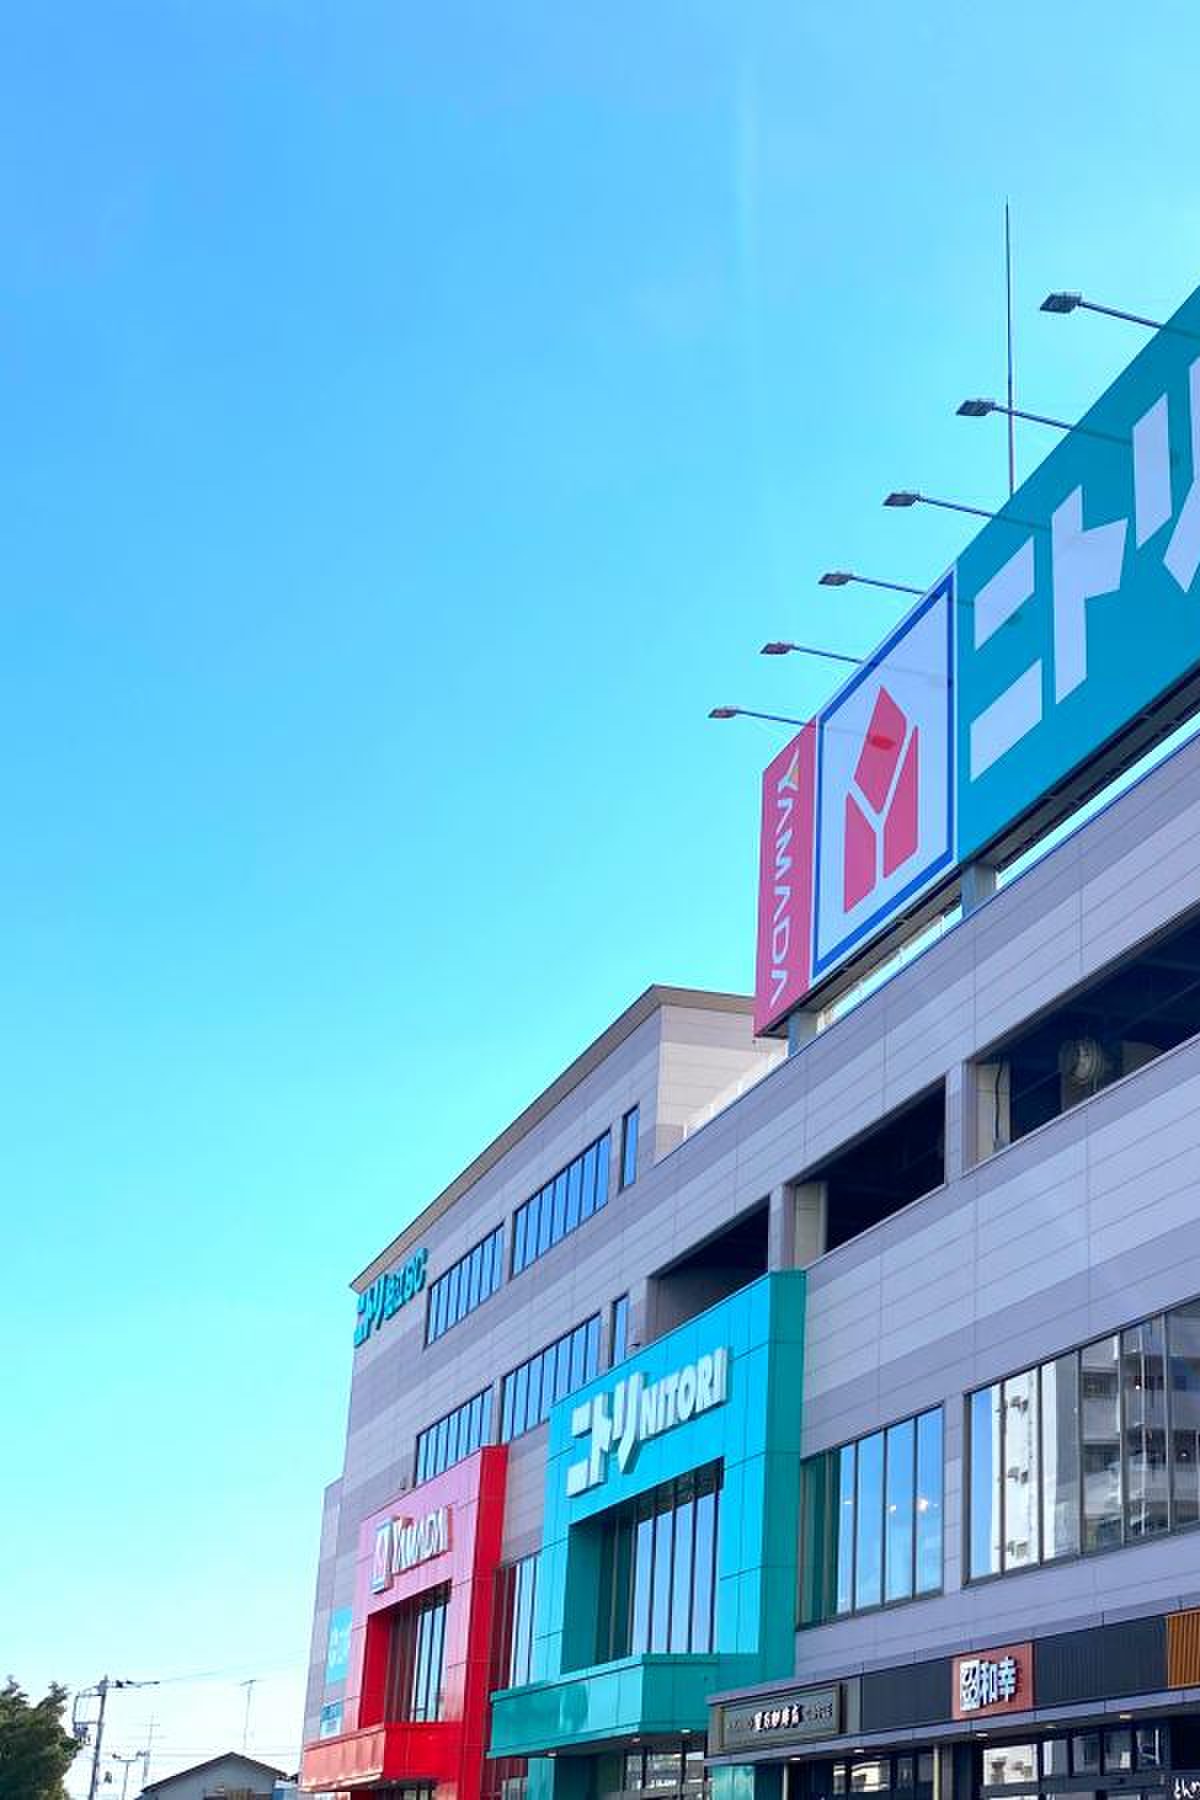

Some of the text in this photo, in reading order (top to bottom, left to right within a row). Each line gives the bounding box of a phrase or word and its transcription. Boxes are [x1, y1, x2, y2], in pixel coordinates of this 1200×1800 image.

[769, 748, 800, 1009] YAMADA
[566, 1346, 730, 1498] ニトリ NITORI
